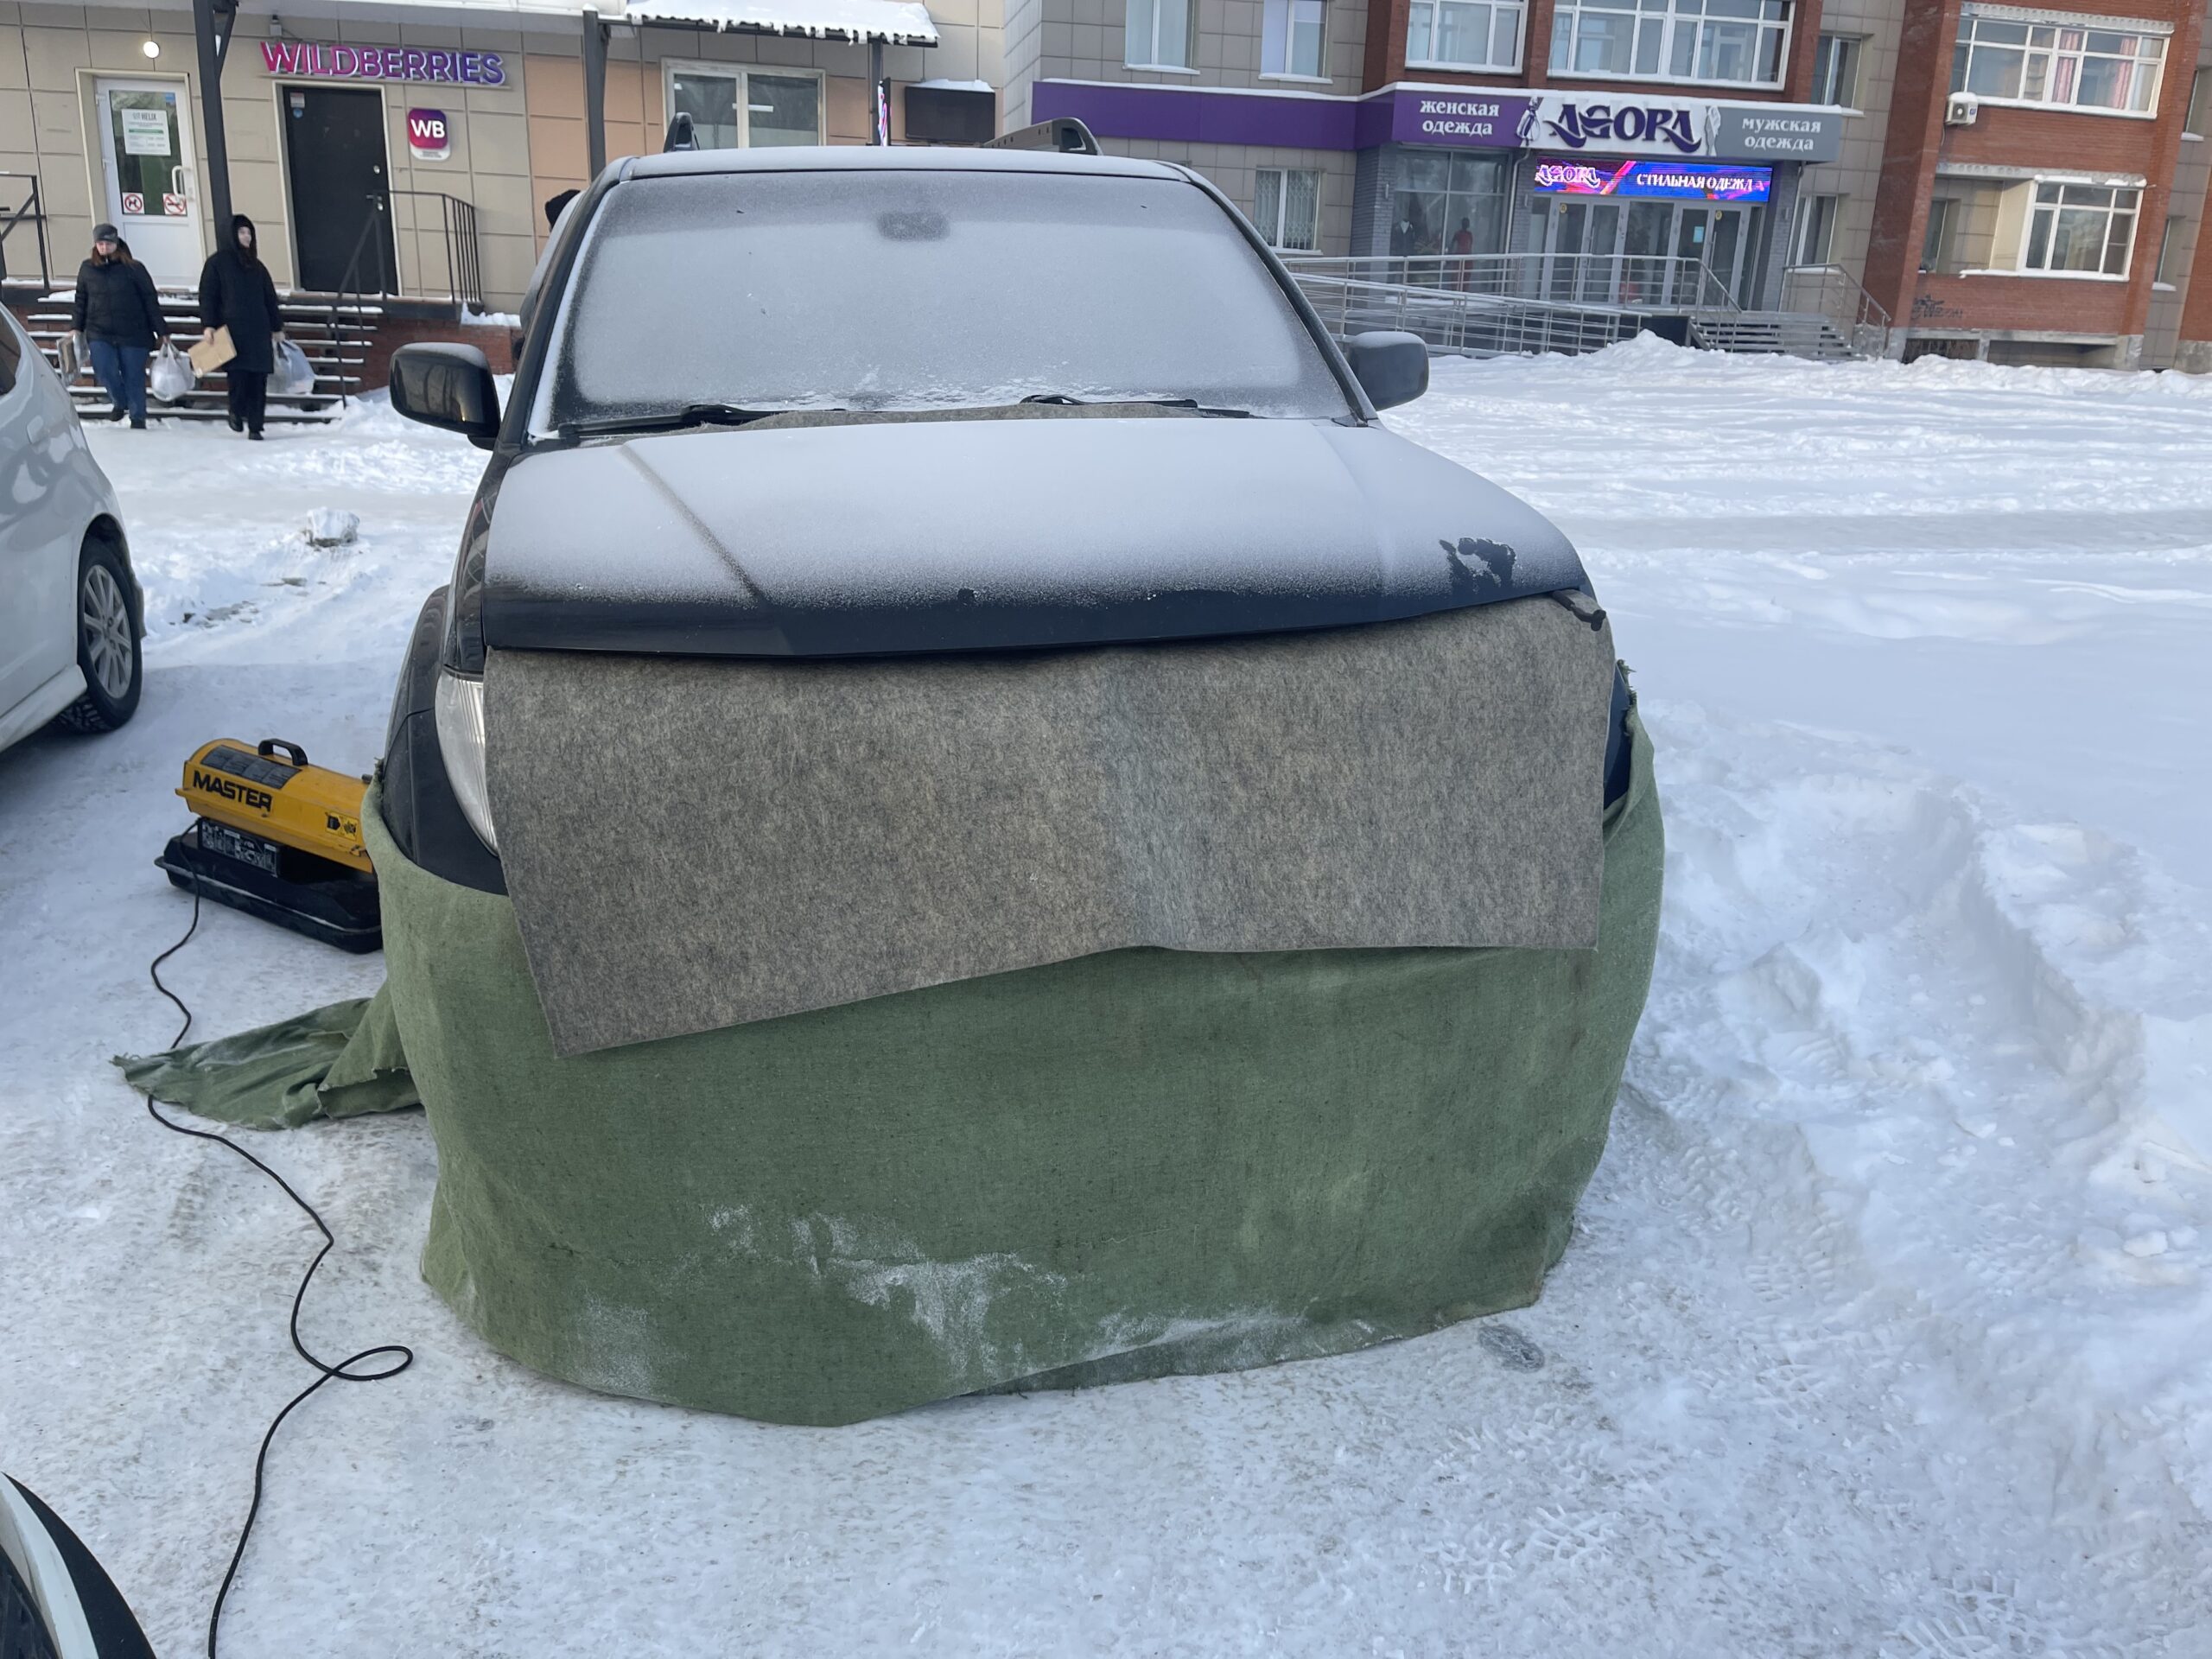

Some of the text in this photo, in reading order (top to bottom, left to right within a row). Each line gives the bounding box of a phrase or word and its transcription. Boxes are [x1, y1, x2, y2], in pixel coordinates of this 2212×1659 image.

[261, 41, 506, 86] WILDBERRIES
[1420, 99, 1500, 117] женская
[410, 118, 446, 138] WB
[1422, 119, 1494, 137] одежда
[1543, 103, 1702, 154] AGORA
[1741, 118, 1821, 133] мужская
[1744, 136, 1815, 152] одежда
[1637, 173, 1705, 189] СТИЛЬНАЯ
[193, 769, 273, 812] MASTER
